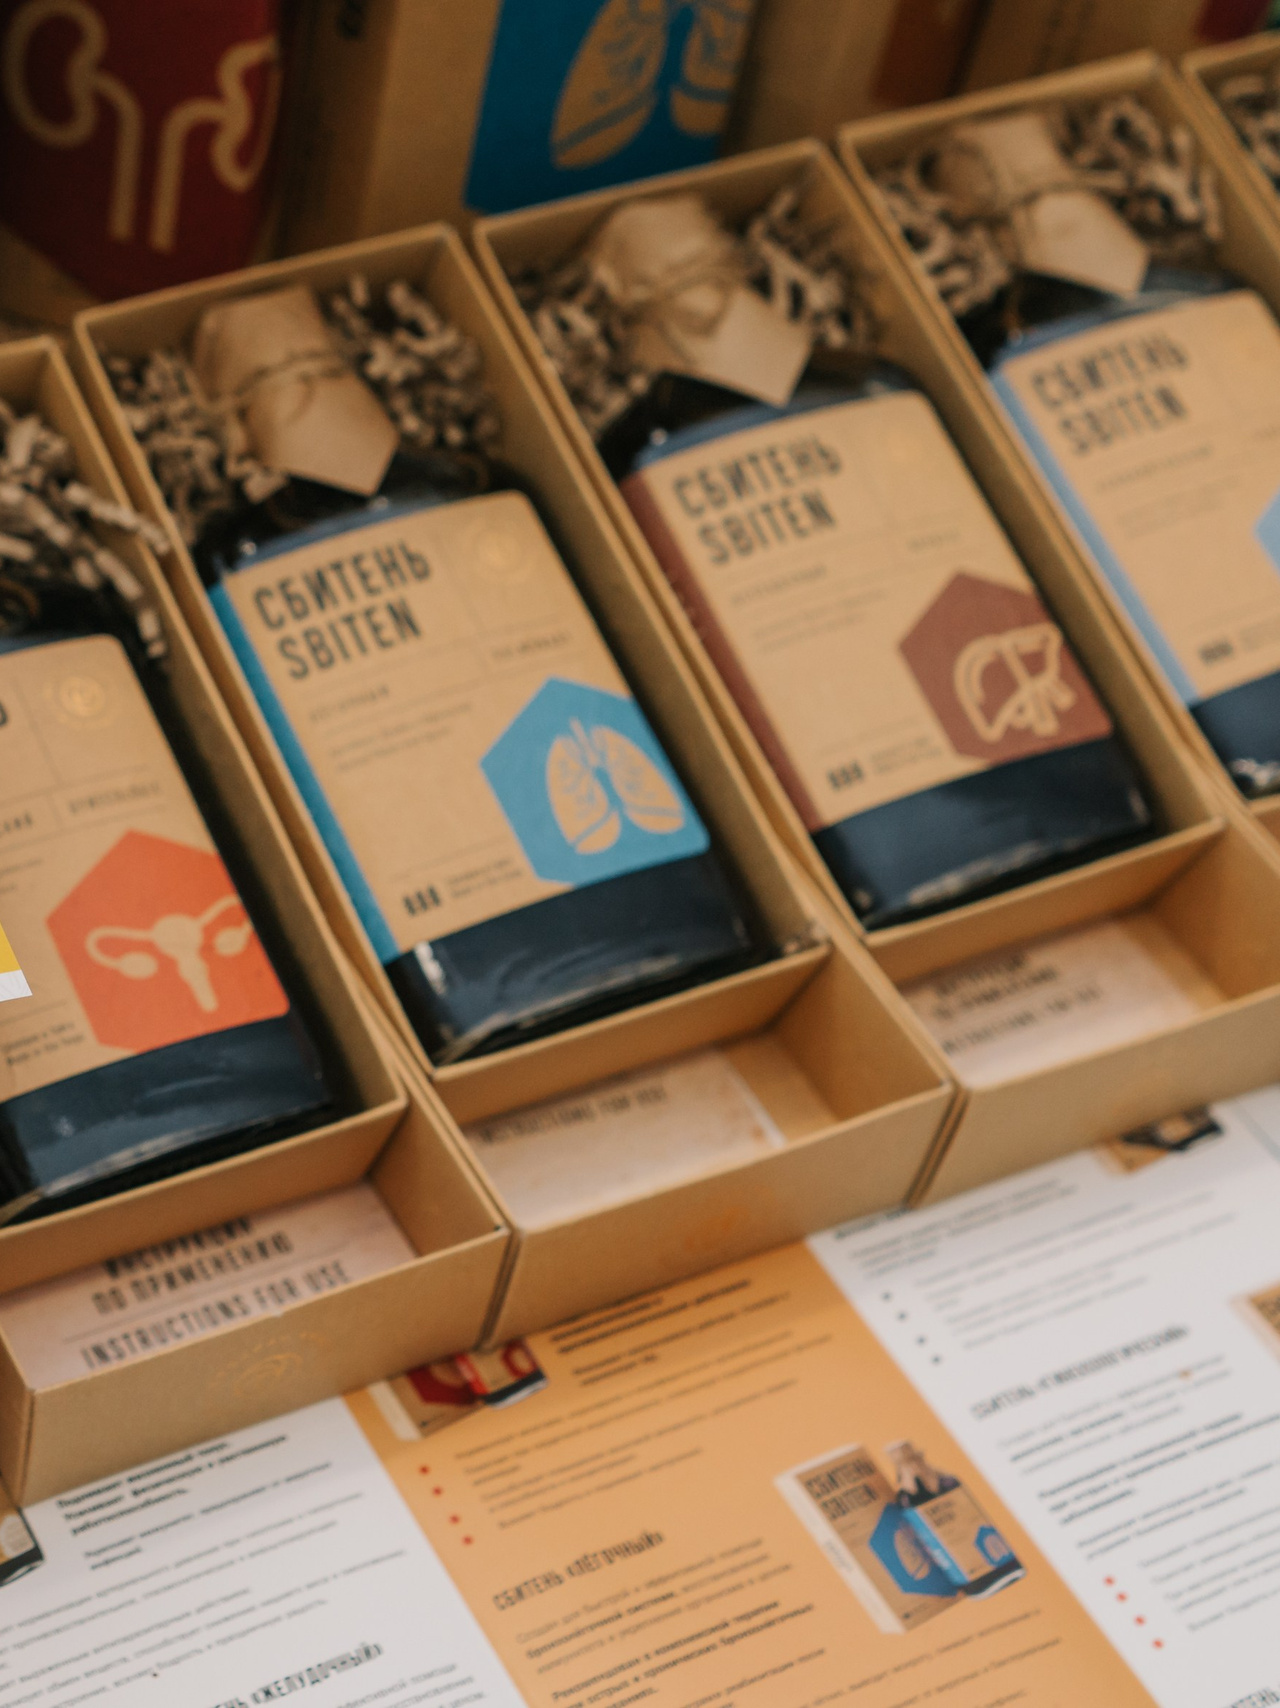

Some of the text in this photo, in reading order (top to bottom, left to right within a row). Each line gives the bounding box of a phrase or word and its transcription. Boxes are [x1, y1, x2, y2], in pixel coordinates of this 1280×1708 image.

[672, 434, 842, 520] СБИТЕНЬ
[698, 490, 837, 567] SBITEN
[253, 539, 432, 632] СБИТЕНЬ
[277, 596, 424, 682] SBITEN
[79, 1259, 352, 1370] INSTRUCTIONS FOR USE
